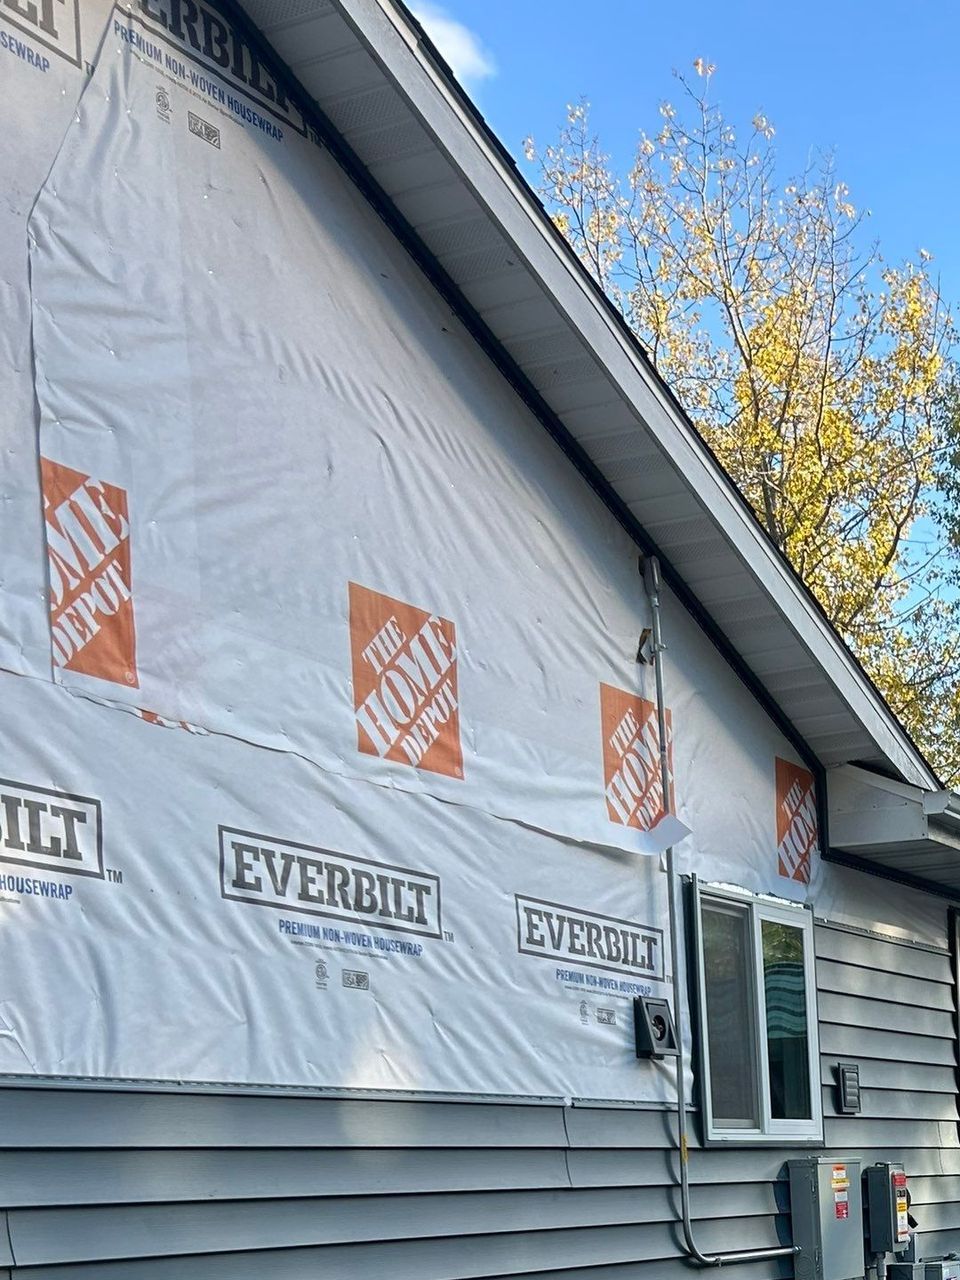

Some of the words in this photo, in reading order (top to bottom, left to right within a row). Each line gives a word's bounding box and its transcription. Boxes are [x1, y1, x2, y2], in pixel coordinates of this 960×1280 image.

[113, 19, 163, 64] PREMIUM
[165, 52, 227, 105] NON-WOVEN
[226, 94, 285, 143] HOUSEWRAP
[52, 559, 132, 669] DEPOT
[361, 615, 407, 676] THE
[355, 613, 458, 759] HOME
[400, 678, 458, 768] DEPOT
[609, 707, 640, 759] THE
[781, 778, 804, 820] THE
[0, 873, 73, 900] HOUSEWRAP
[231, 841, 432, 926] EVERBILT
[278, 919, 321, 940] PREMIUM
[322, 926, 373, 948] NON-WOVEN
[374, 936, 424, 957] HOUSEWRAP
[523, 906, 658, 971] EVERBILT
[555, 968, 585, 985] PREMIUM
[585, 973, 619, 991] NON-WOVEN
[619, 980, 652, 997] HOUSEWRAP
